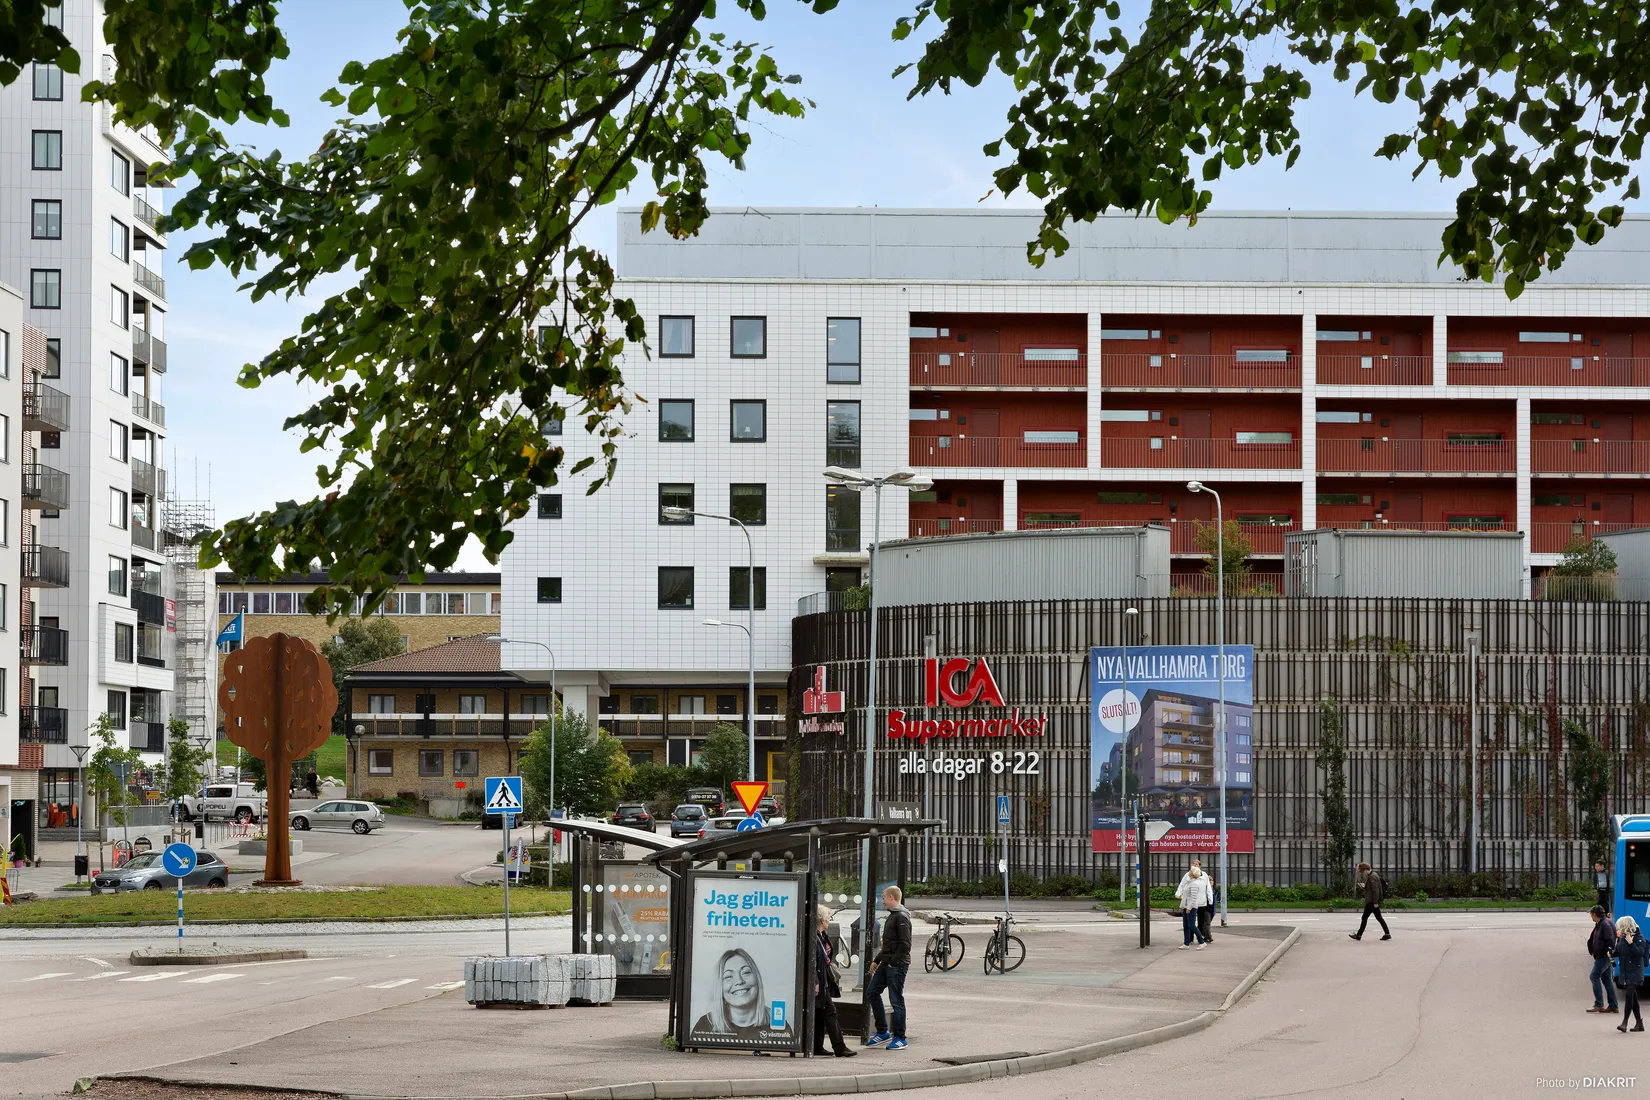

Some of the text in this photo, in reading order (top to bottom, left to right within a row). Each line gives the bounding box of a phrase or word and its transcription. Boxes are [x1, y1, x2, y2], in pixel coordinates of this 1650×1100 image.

[1097, 656, 1124, 680] NYA
[1127, 654, 1208, 679] VALLHAMRA
[926, 656, 1006, 708] ICA
[887, 706, 1048, 745] Supermarket
[899, 751, 1040, 780] alla dagar 8-22
[703, 889, 789, 910] Jag gillar
[706, 910, 785, 928] friheten.
